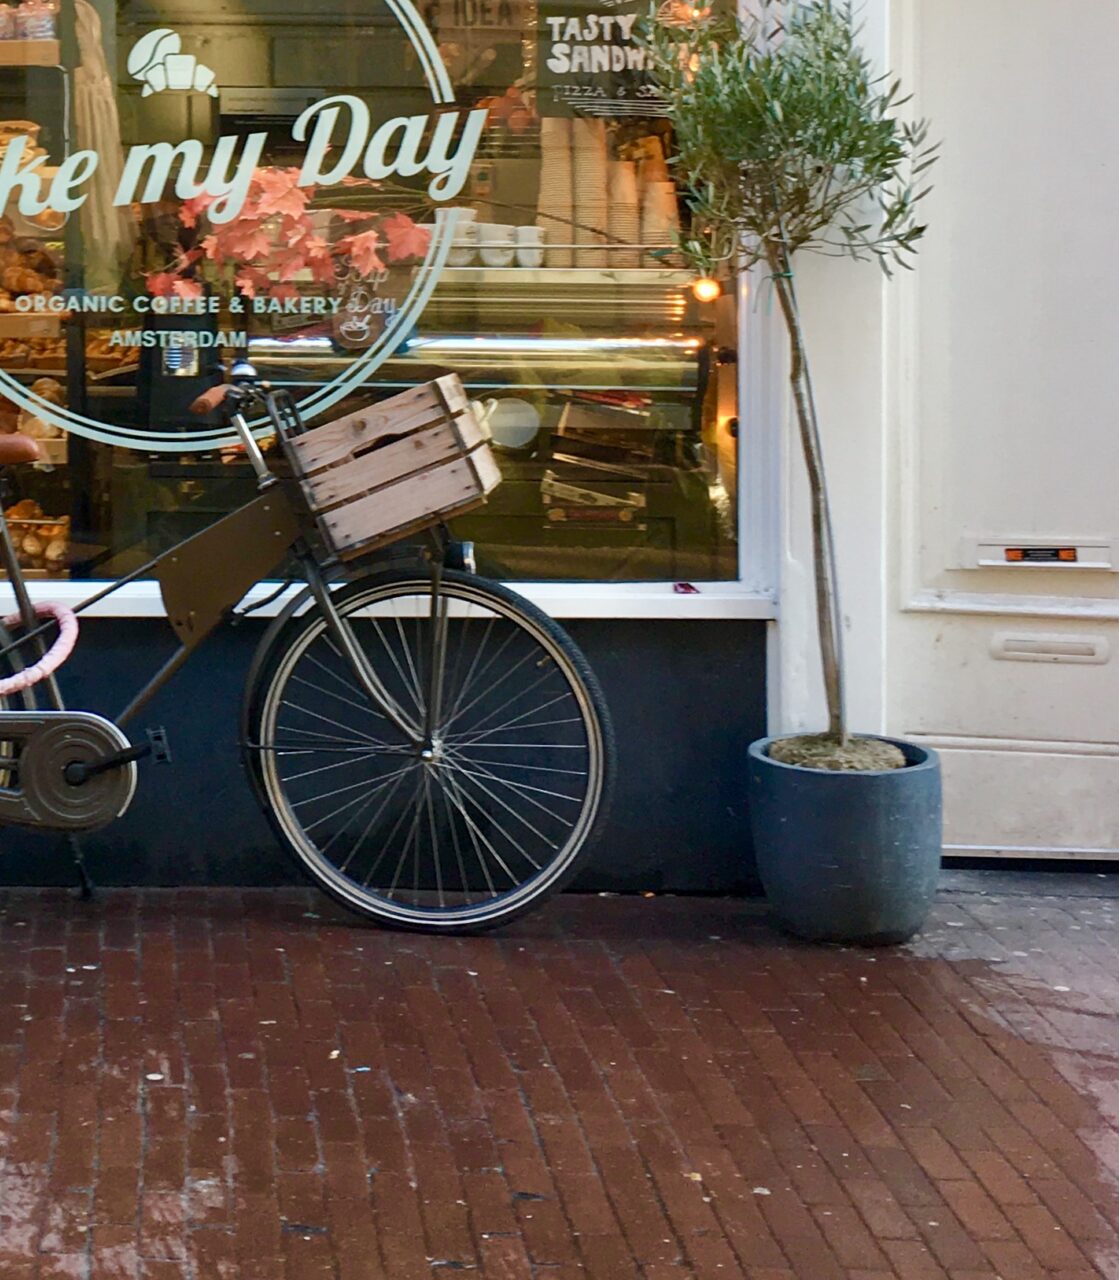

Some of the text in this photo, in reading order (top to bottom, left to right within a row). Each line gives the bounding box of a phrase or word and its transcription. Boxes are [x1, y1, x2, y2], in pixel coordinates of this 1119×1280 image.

[546, 14, 637, 41] TASTY
[552, 84, 607, 102] PIZZA
[112, 132, 268, 223] my
[292, 94, 488, 201] Day
[15, 295, 343, 314] ORGANIC COFFEE & BAKERY
[108, 330, 247, 347] AMSTERDAM
